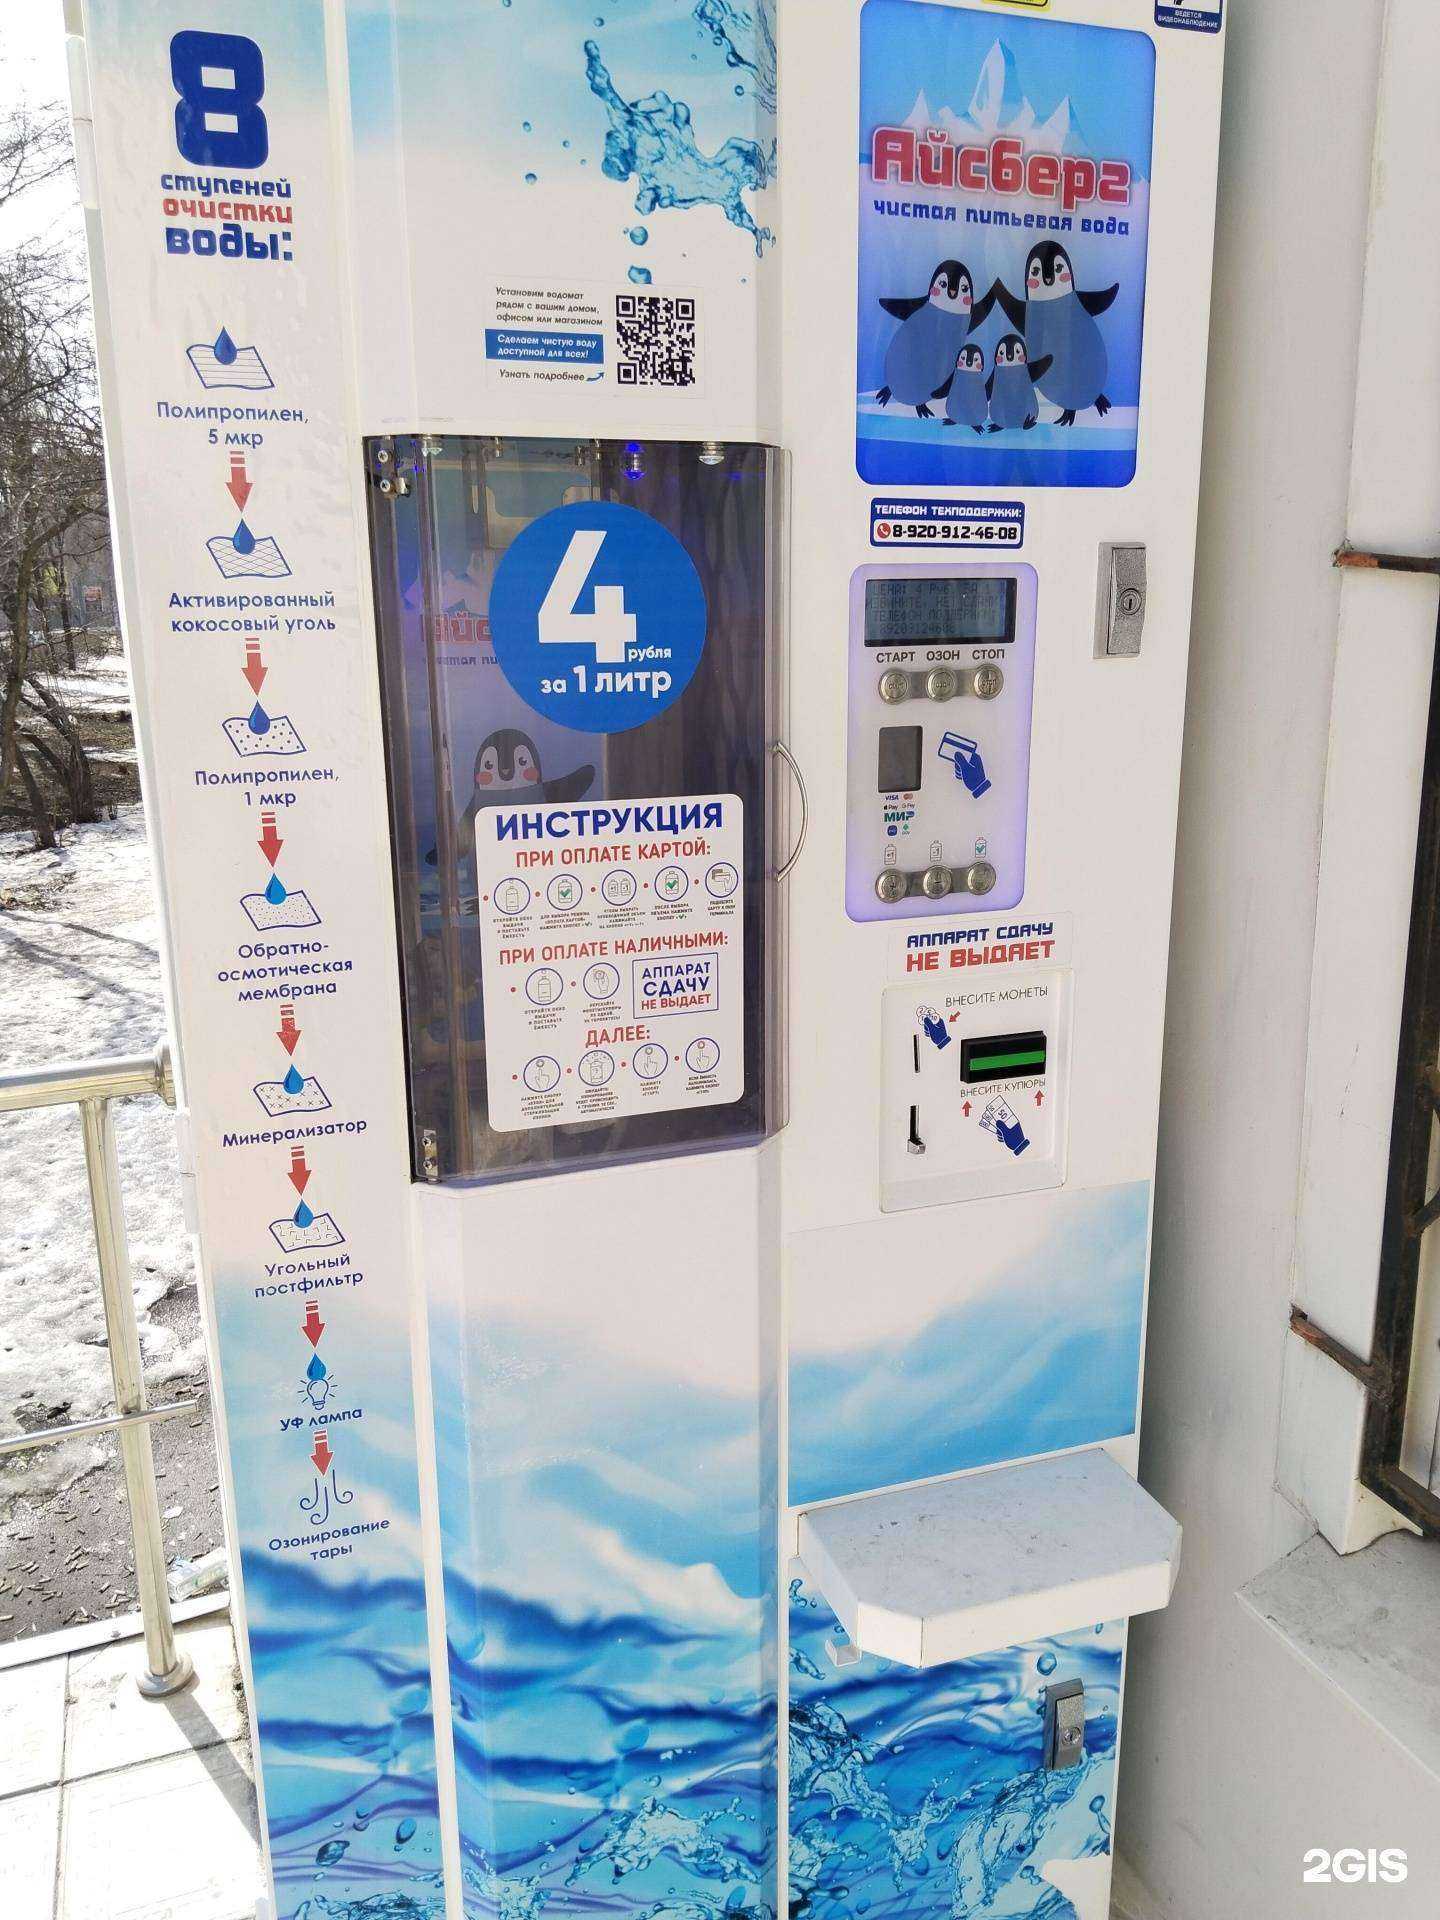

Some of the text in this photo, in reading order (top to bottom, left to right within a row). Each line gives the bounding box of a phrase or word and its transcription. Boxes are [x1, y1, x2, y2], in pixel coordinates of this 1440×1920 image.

[1157, 14, 1218, 28] ВИДЕОНАБЛЮДЕНИЕ
[1174, 9, 1202, 19] ВЕДЕТСЯ
[170, 30, 269, 169] 8
[872, 127, 1130, 212] Айсберг
[161, 174, 291, 198] ступеней
[163, 198, 292, 223] очистки
[874, 200, 1129, 235] чистая питьевая вода
[166, 223, 292, 260] воды:
[496, 287, 584, 300] Установим водомат
[496, 301, 524, 310] рядом
[535, 303, 565, 311] вашим
[567, 304, 600, 314] домом,
[496, 313, 603, 326] офисом или магазином
[497, 334, 597, 349] Сделаем чистую воду
[498, 347, 589, 359] доступной для всех!
[499, 369, 585, 381] Узнать подробнее
[157, 401, 309, 424] Полипропилен,
[208, 428, 263, 449] 5 мкр
[875, 505, 1022, 518] ТЕЛЕФОН ТЕХПОДДЕРЖКИ:
[892, 525, 1018, 540] 8-920-912-46-08
[168, 591, 335, 611] Активированный
[538, 530, 672, 663] 4 рубля
[172, 615, 336, 634] кокосовый уголь
[876, 649, 1005, 663] СТАРТ ОЗОН СТОП
[540, 665, 672, 698] за 1 литр
[195, 768, 340, 786] Полипропилен,
[244, 791, 297, 808] 1 мкр
[496, 802, 723, 841] ИНСТРУКЦИЯ
[884, 810, 915, 823] МИР
[516, 836, 711, 868] ПРИ ОПЛАТЕ КАРТОЙ:
[907, 922, 1054, 948] АППАРАТ СДАЧУ
[238, 941, 329, 960] Обратно-
[499, 930, 729, 965] ПРИ ОПЛАТЕ НАЛИЧНЫМИ:
[906, 940, 1055, 972] НЕ ВЫДАЕТ
[218, 960, 353, 982] осмотическая
[642, 961, 711, 980] АППАРАТ
[238, 982, 337, 1002] мембрана
[643, 976, 710, 998] СДАЧУ
[945, 985, 1048, 1007] ВНЕСИТЕ МОНЕТЫ
[641, 993, 712, 1011] НЕ ВЫДАЕТ
[585, 1024, 651, 1049] ДАЛЕЕ:
[960, 1078, 1046, 1098] ВНЕСИТЕ КУПЮРЫ
[223, 1120, 367, 1148] Минерализатор
[265, 1253, 351, 1277] Угольный
[255, 1272, 364, 1298] постфильтр
[309, 1408, 363, 1426] лампа
[268, 1519, 390, 1551] Озонирование
[310, 1544, 353, 1561] тары
